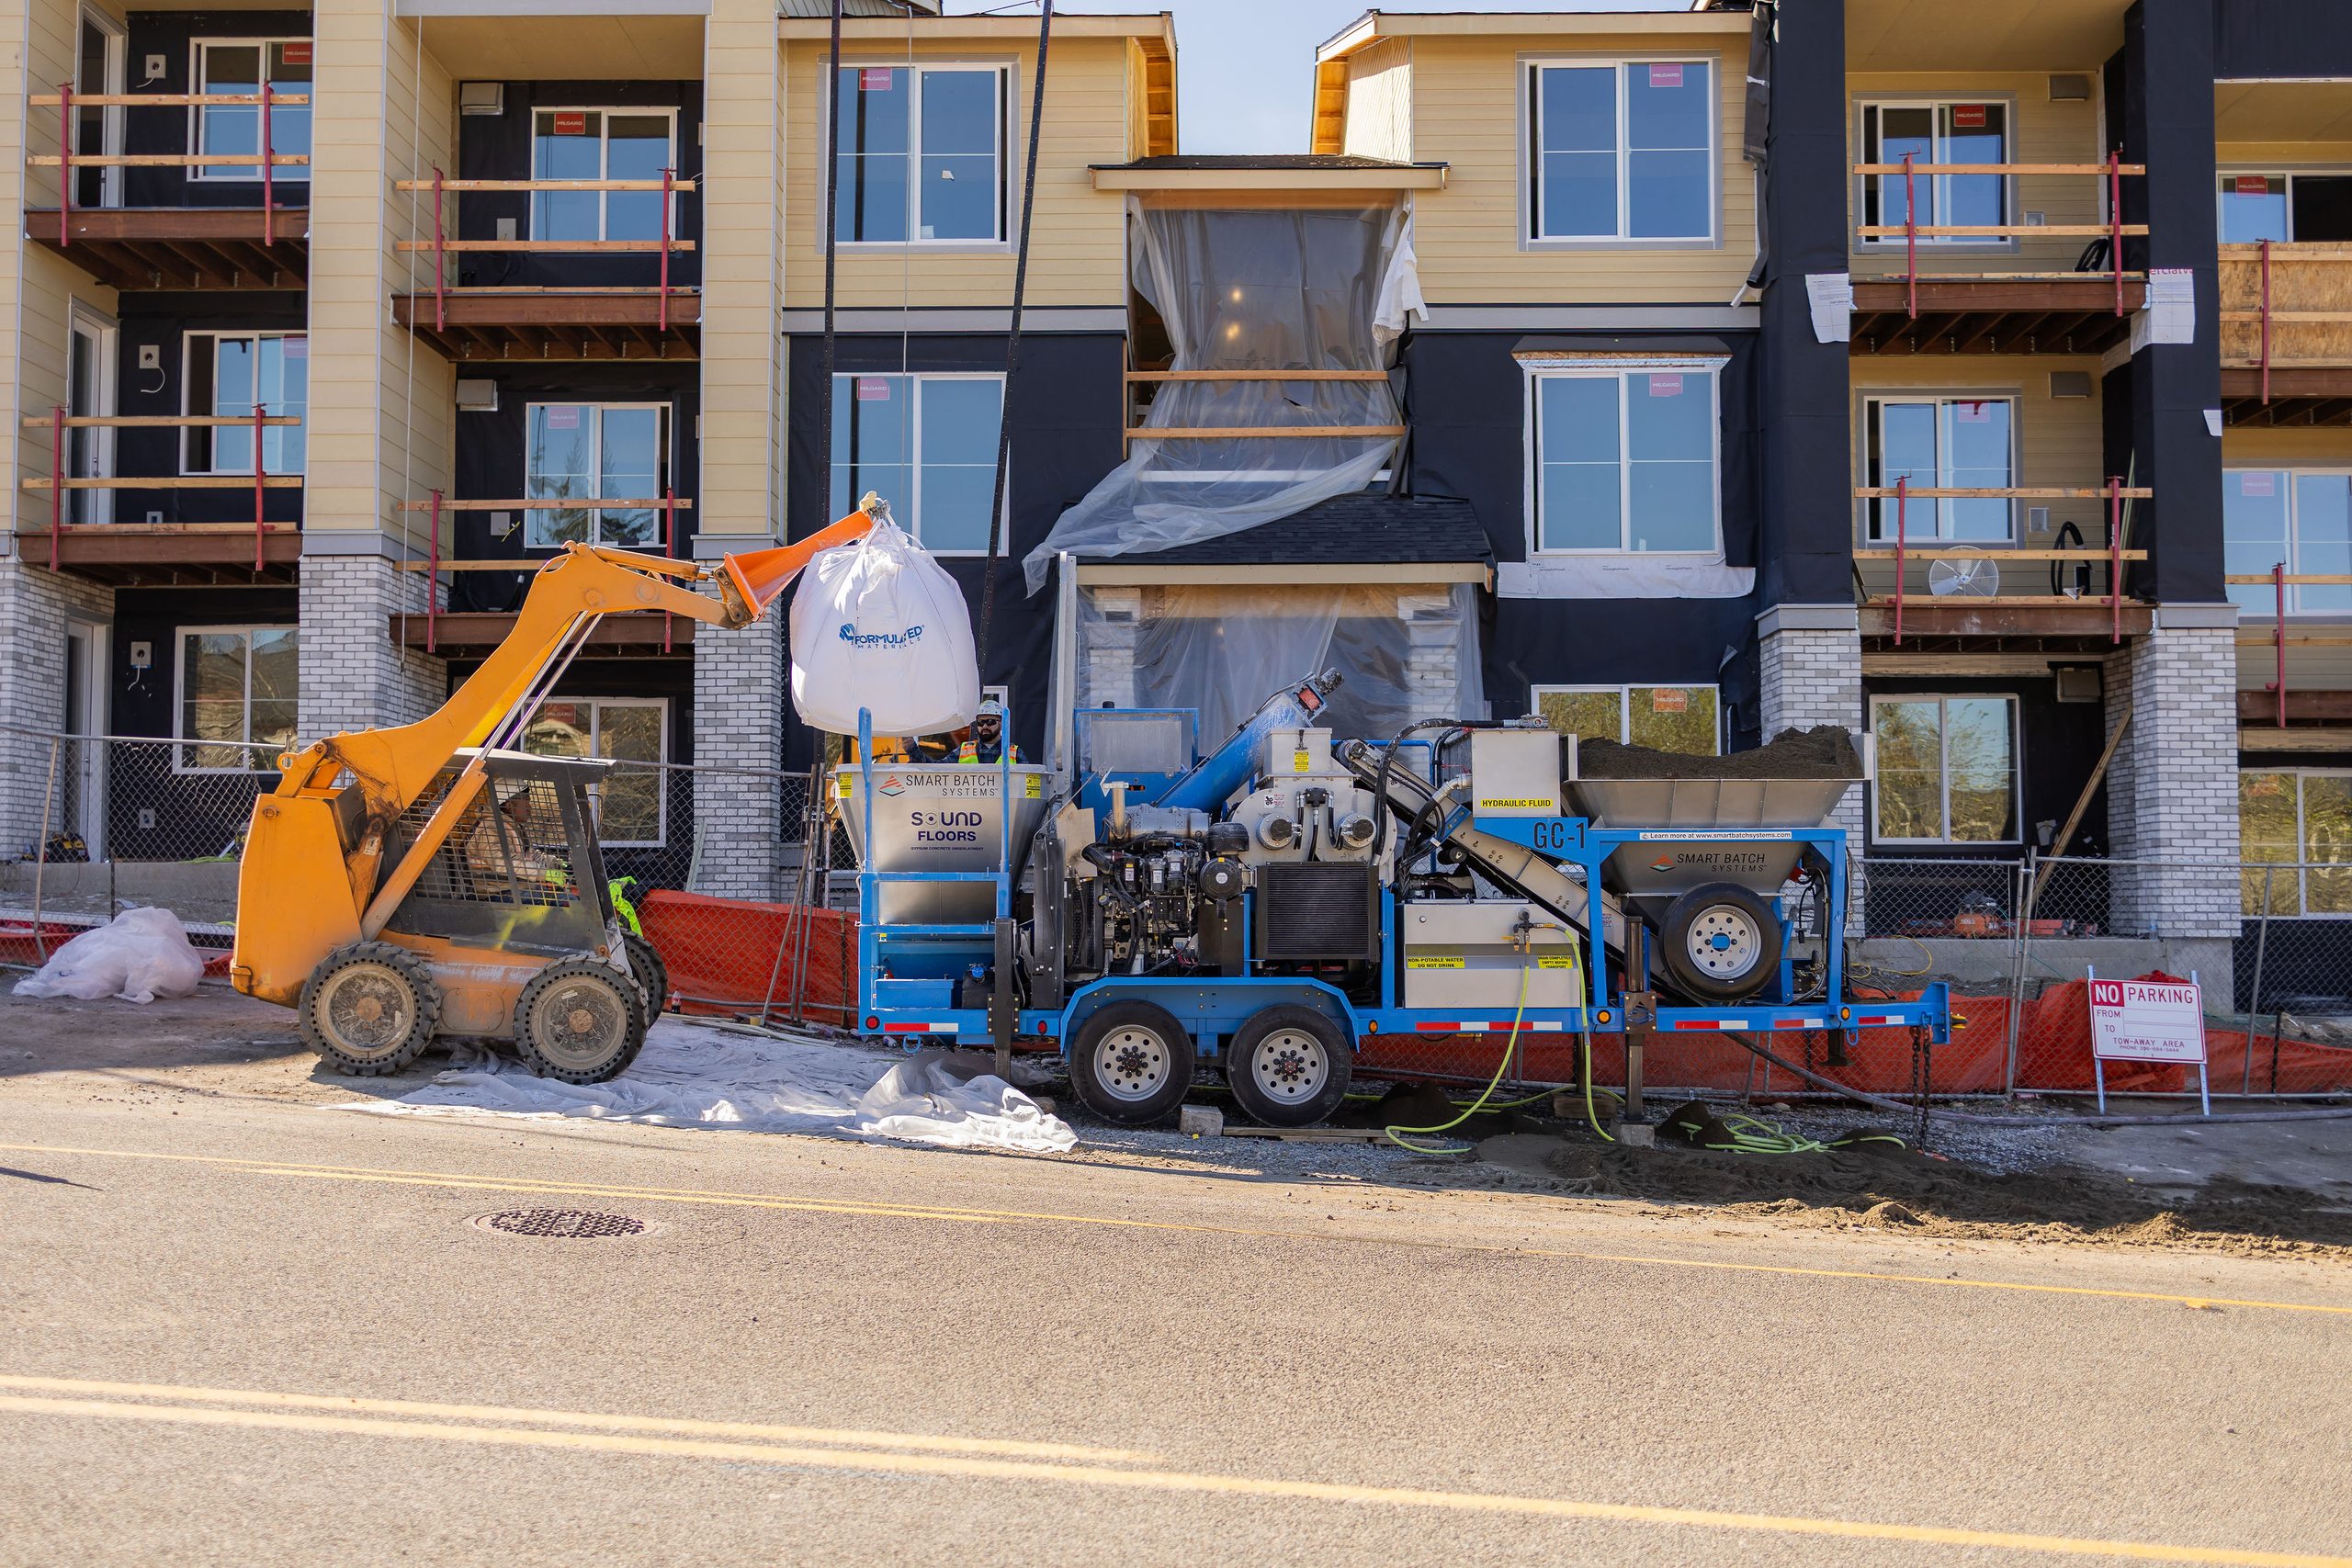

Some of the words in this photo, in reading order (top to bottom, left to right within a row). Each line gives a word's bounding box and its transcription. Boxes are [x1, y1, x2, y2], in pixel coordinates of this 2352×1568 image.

[906, 774, 949, 786] SMART
[954, 774, 995, 786] BATCH
[943, 788, 995, 796] SYSTEMS
[1482, 799, 1526, 807] HYDRAULIC
[1529, 799, 1551, 807] FLUID
[918, 830, 977, 841] FLOORS
[1533, 822, 1585, 849] GC-1
[1696, 831, 1791, 840] www.smartbatchsystems.com
[1677, 853, 1720, 863] SMART
[1724, 853, 1765, 863] BATCH
[1712, 864, 1764, 873] SYSTEMS
[2095, 984, 2120, 1003] NO
[2128, 987, 2193, 1004] PARKING
[2097, 1010, 2120, 1019] FROM
[2104, 1024, 2116, 1033] TO
[2113, 1037, 2155, 1046] TOW-AWAY
[2162, 1040, 2185, 1048] AREA
